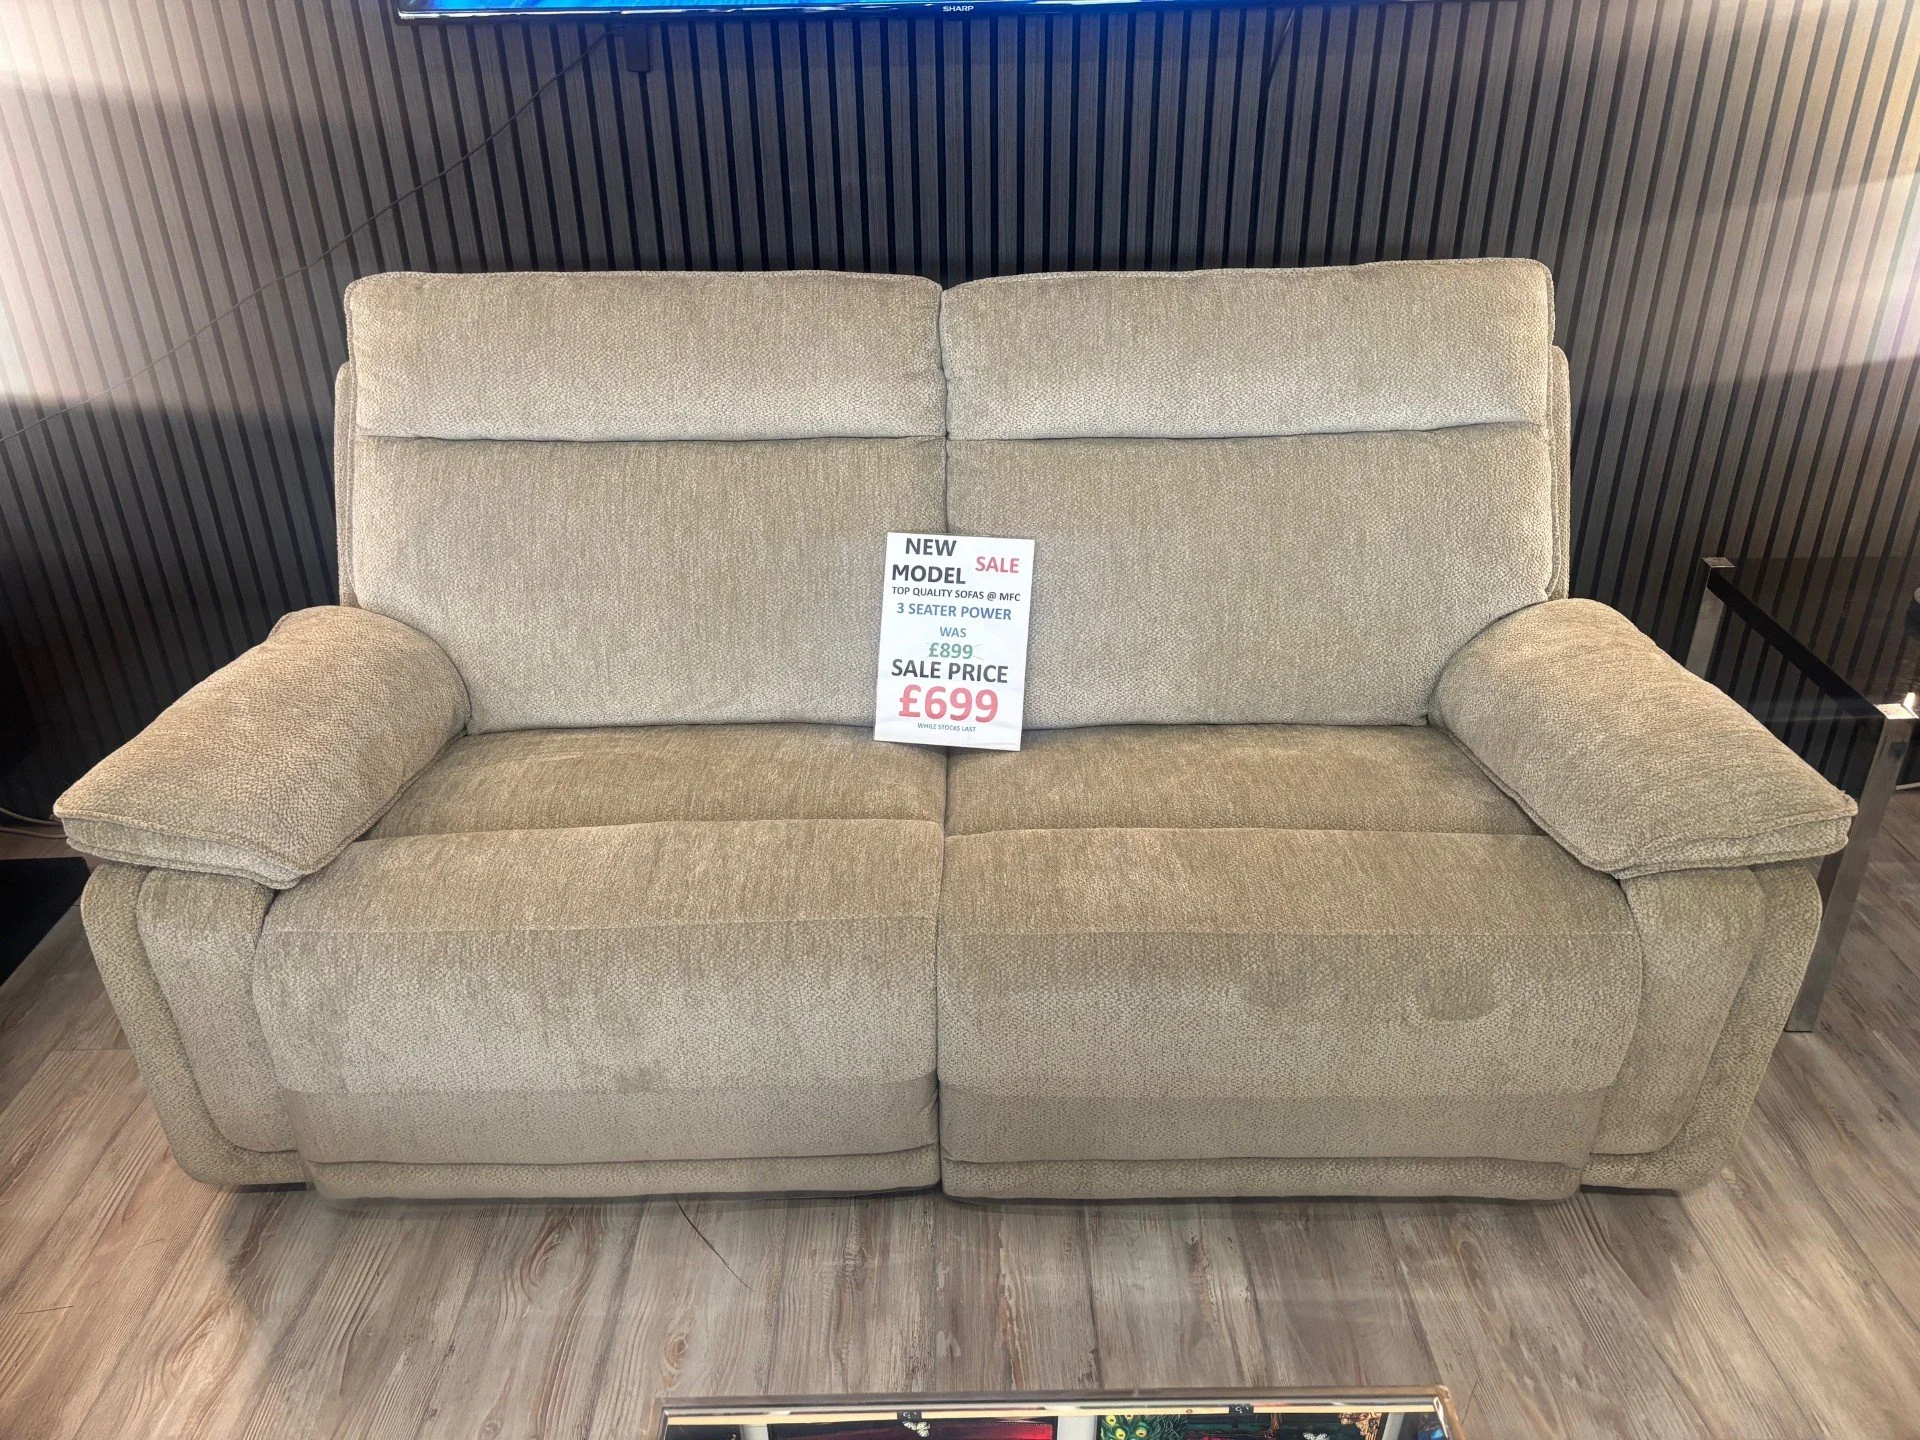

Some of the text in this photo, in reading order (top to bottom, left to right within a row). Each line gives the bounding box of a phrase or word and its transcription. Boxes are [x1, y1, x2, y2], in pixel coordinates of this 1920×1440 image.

[905, 538, 956, 556] NEW
[975, 556, 1019, 573] SALE
[891, 565, 965, 584] MODEL
[892, 587, 1020, 601] TOP QUALITY SOFAS @ MFC
[896, 603, 1011, 620] 3 SEATER POWER
[939, 626, 966, 638] WAS
[928, 642, 973, 659] £899
[891, 659, 1008, 683] SALE PRICE
[898, 684, 998, 723] £699
[917, 722, 936, 730] WHILE
